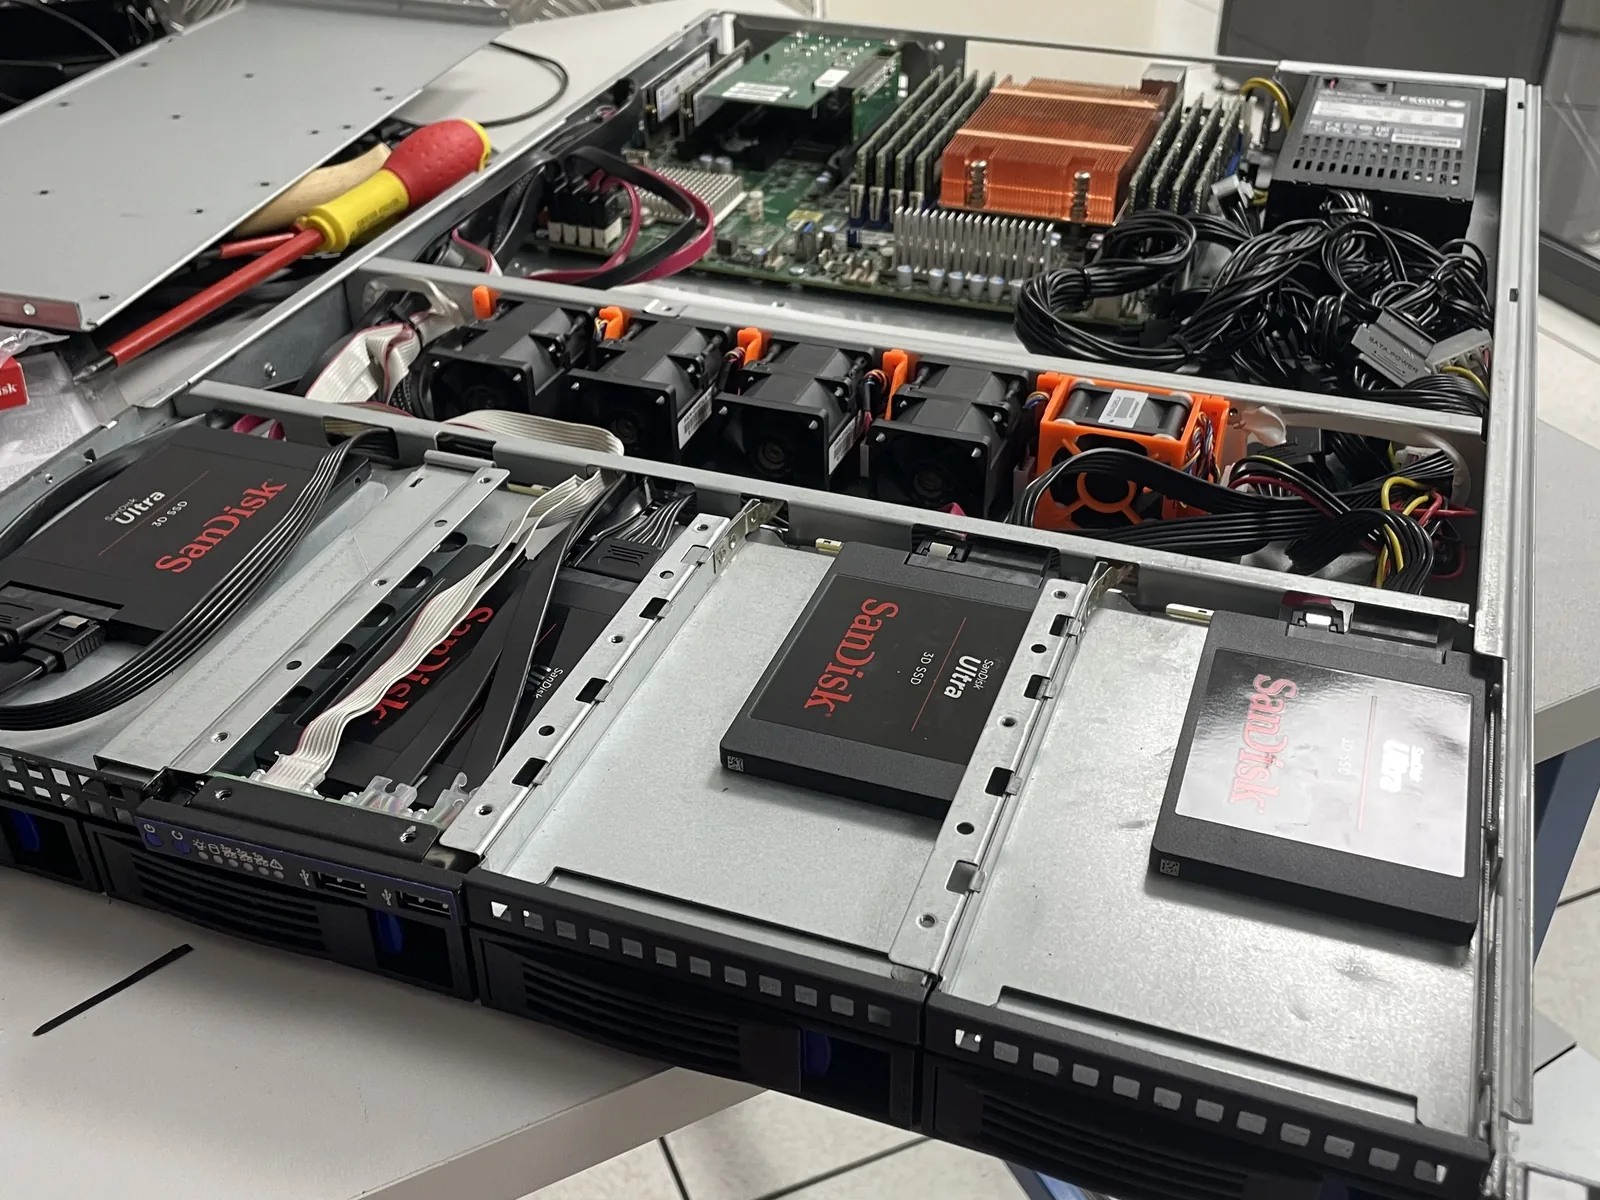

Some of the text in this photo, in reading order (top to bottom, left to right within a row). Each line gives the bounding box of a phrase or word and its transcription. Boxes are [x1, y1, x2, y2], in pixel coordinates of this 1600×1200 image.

[1368, 336, 1419, 374] SATA POWER
[104, 497, 138, 522] SanDisk
[114, 491, 166, 525] Ultra
[151, 500, 188, 528] 3D SSD
[154, 483, 287, 573] SanDisk
[803, 598, 899, 712] SanDisk
[910, 651, 935, 685] 3D SSD
[535, 667, 564, 699] SanDisk
[943, 655, 982, 699] Ultra
[972, 658, 994, 690] SanDisk
[1228, 673, 1298, 809] SanDisk
[1337, 754, 1352, 776] SSD
